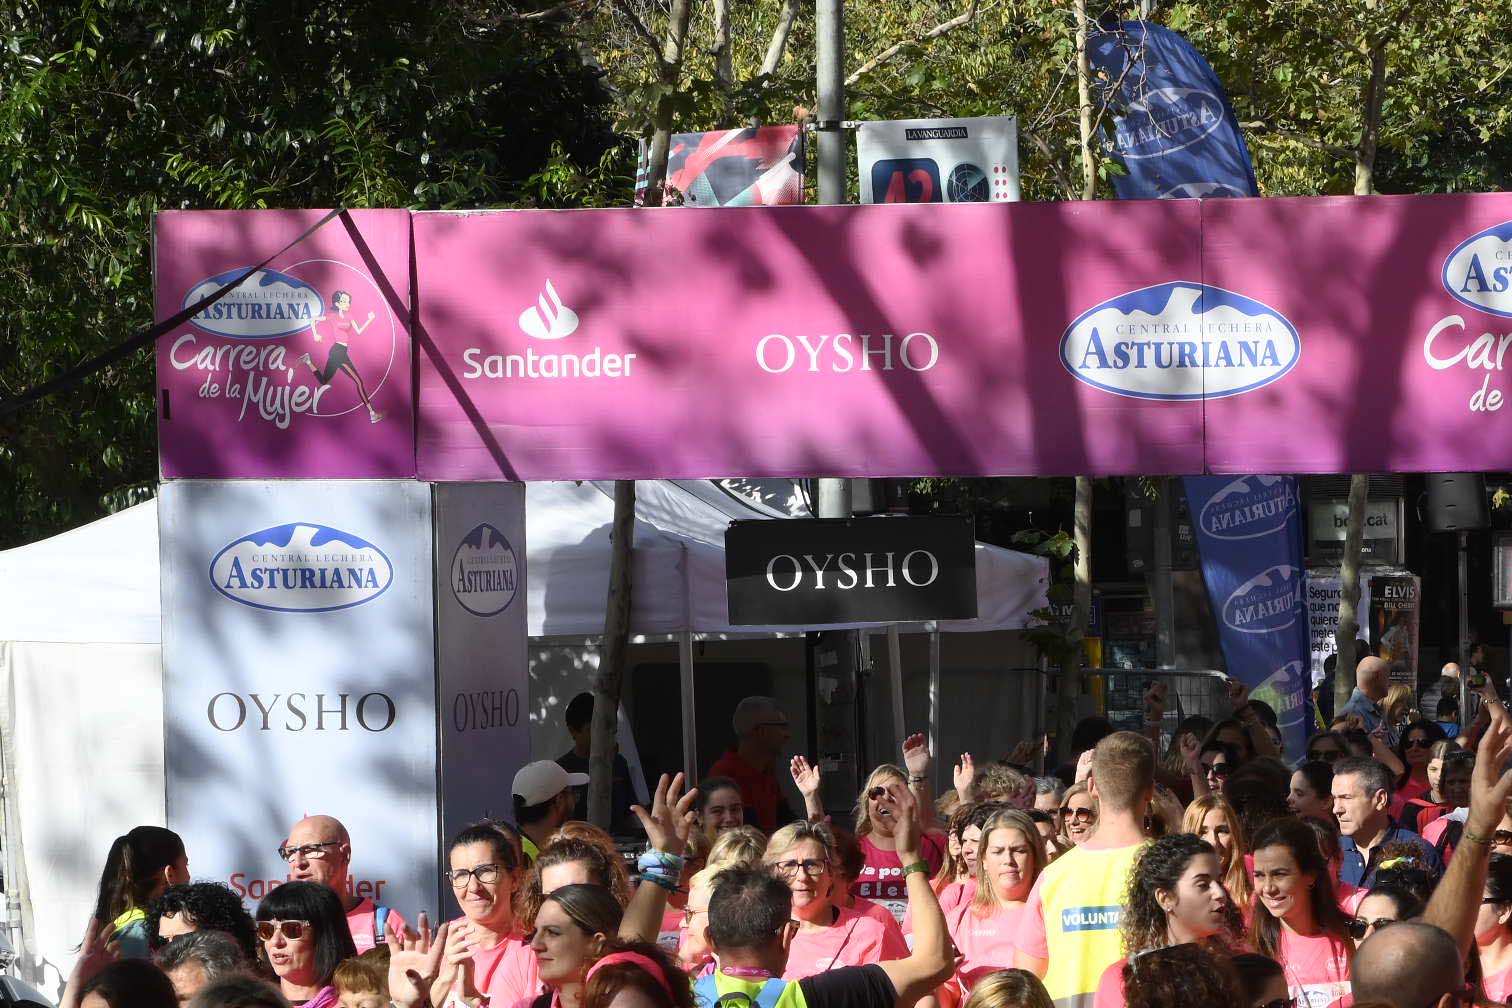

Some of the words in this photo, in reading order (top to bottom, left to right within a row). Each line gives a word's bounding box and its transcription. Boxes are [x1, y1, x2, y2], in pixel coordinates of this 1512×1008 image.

[914, 128, 966, 138] VANGUARDIA
[192, 296, 312, 321] ASTURIANA
[1116, 324, 1189, 334] CENTRAL
[1199, 323, 1272, 333] LECHERA
[170, 334, 286, 370] Carrera
[463, 348, 636, 379] Santander
[755, 332, 939, 374] OYSHO
[1078, 327, 1282, 369] ASTURIANA
[199, 374, 221, 398] de
[226, 372, 241, 398] la
[238, 368, 332, 429] Mujer
[1469, 375, 1504, 412] de
[224, 556, 380, 589] ASTURIANA
[252, 554, 309, 562] CENTRAL
[315, 554, 373, 562] LECHERA
[766, 549, 940, 591] OYSHO
[457, 560, 514, 593] ASTURIANA
[1384, 585, 1415, 599] ELVIS
[1310, 602, 1326, 615] que
[1311, 615, 1341, 627] quiere
[1312, 642, 1330, 652] este
[207, 692, 396, 732] OYSHO
[453, 688, 519, 733] OYSHO
[229, 873, 386, 900] Saner
